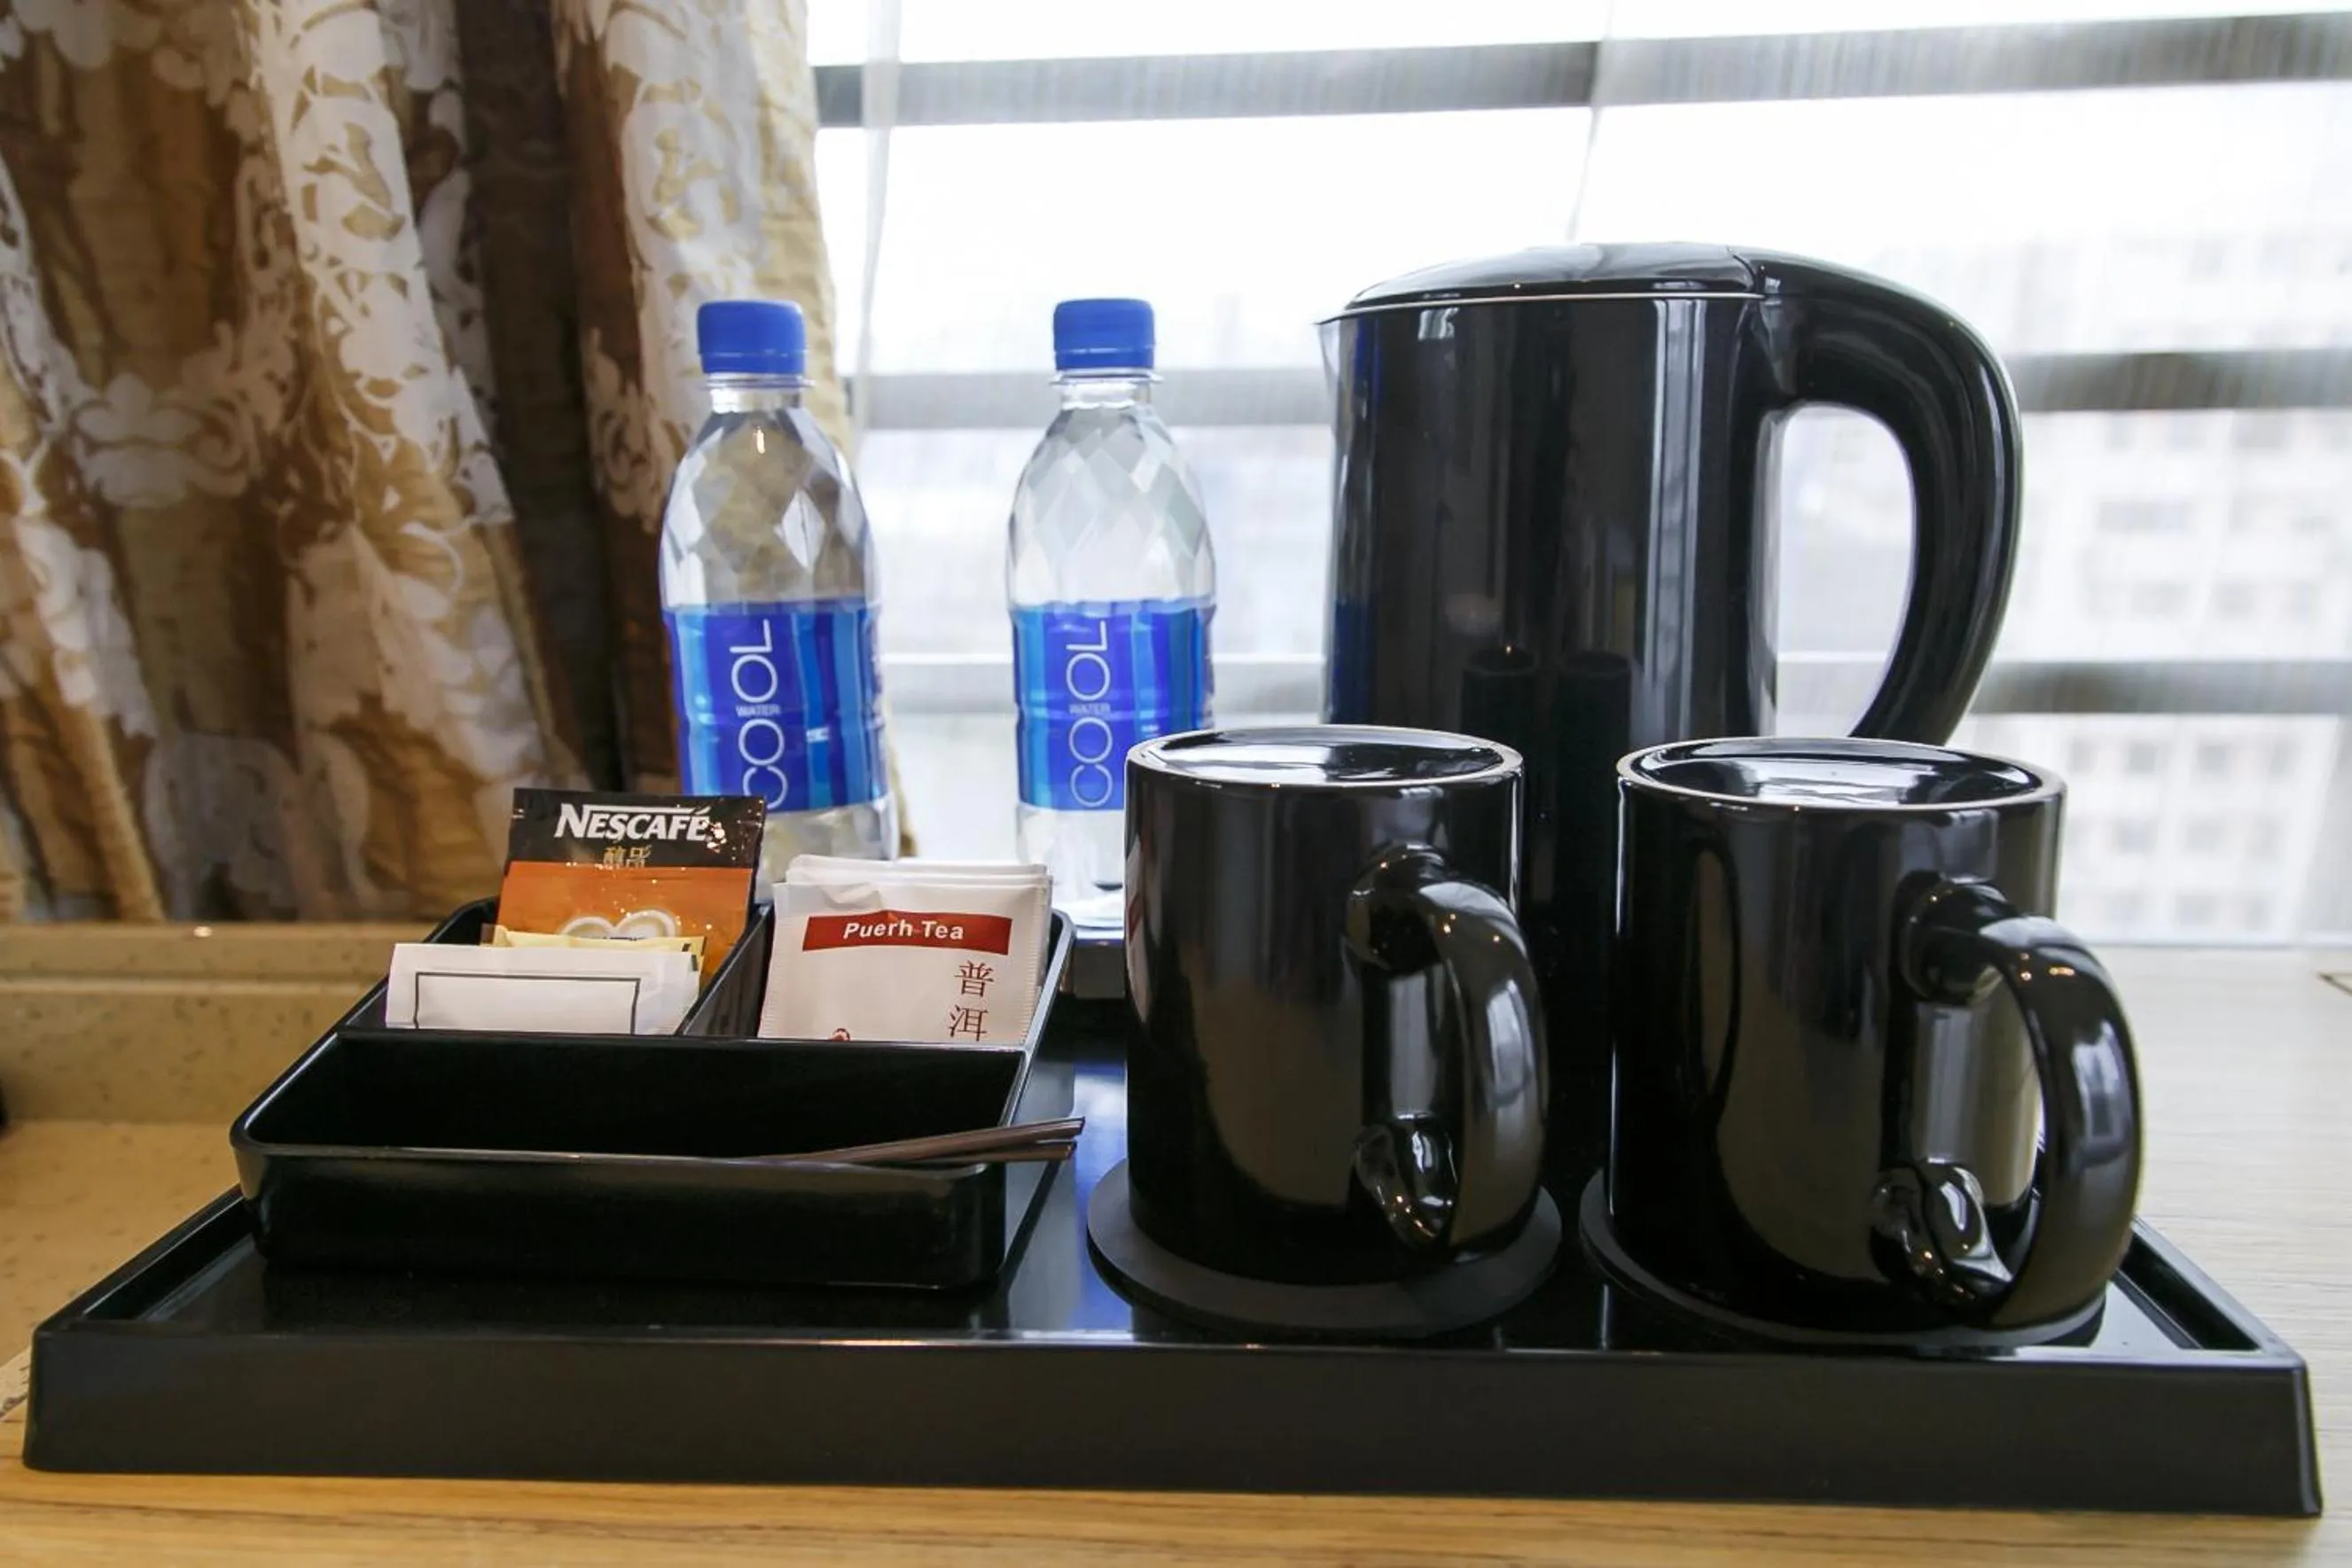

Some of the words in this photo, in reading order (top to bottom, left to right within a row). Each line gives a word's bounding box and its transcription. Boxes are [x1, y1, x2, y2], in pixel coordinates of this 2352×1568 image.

[729, 619, 788, 809] COOL
[1066, 620, 1113, 807] COOL
[554, 803, 714, 842] NESCAFÉ
[843, 917, 913, 940] Puerh
[921, 920, 965, 940] Tea
[949, 960, 995, 1042] 普洱
